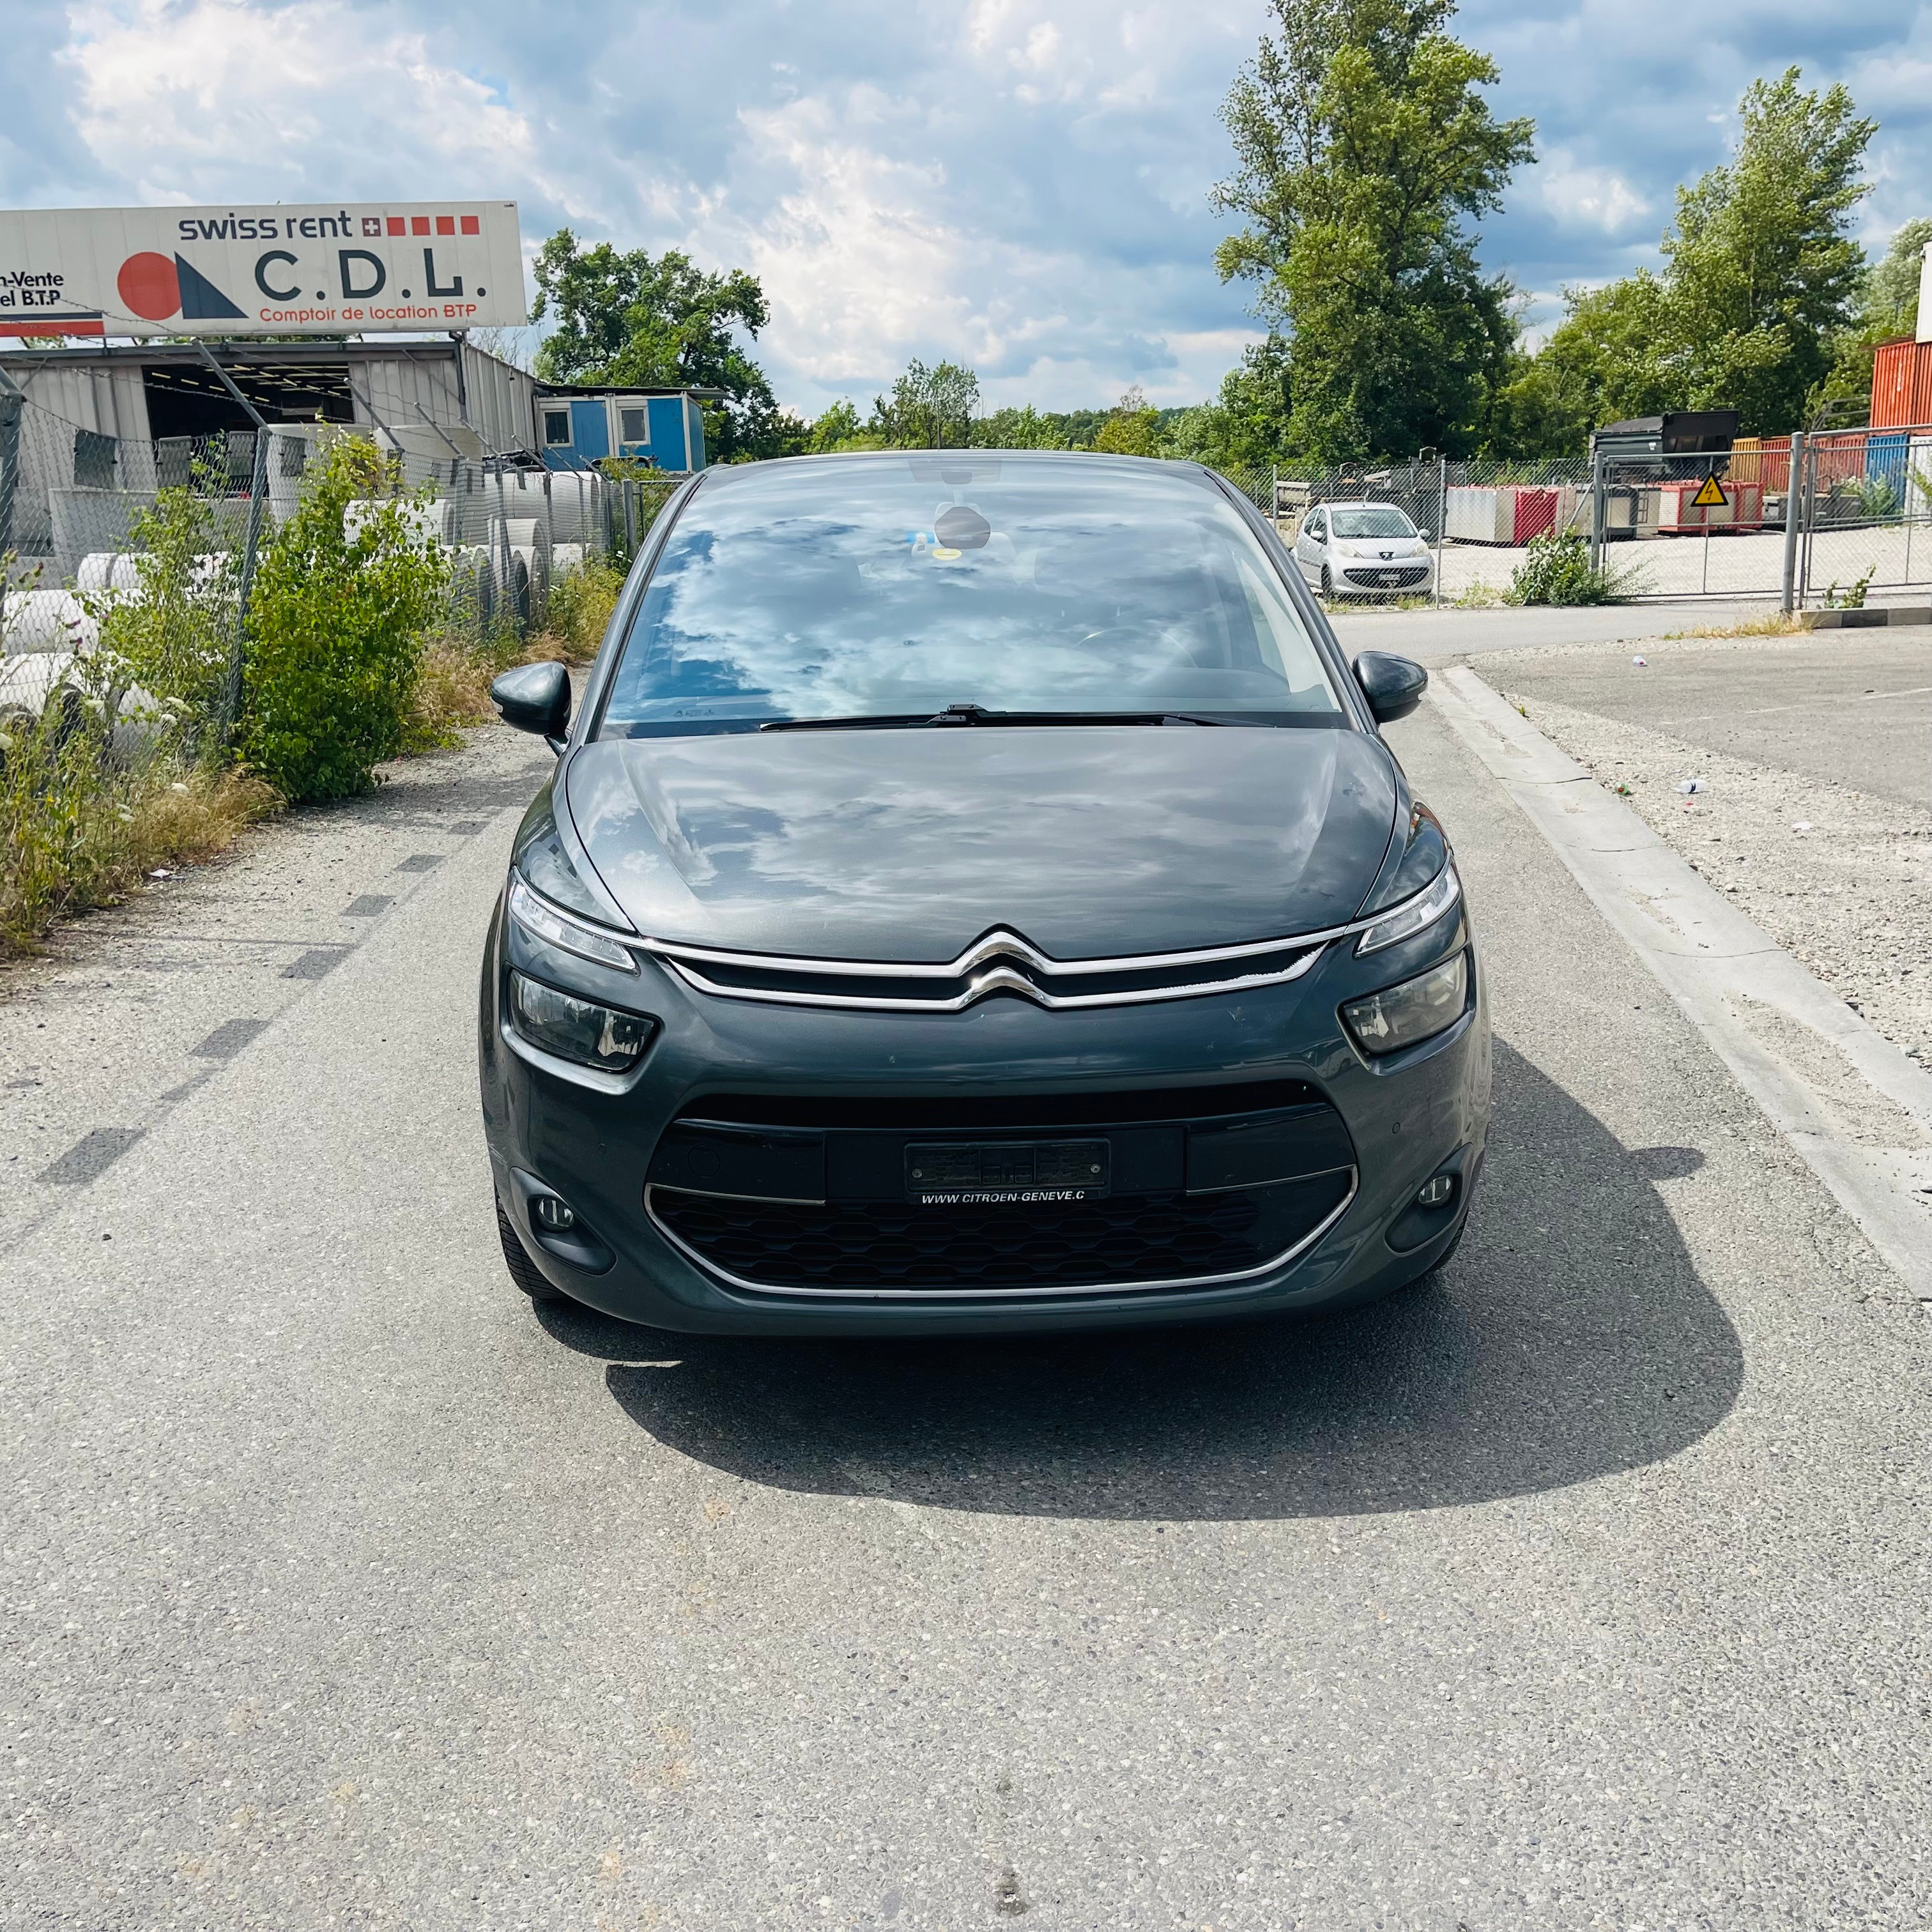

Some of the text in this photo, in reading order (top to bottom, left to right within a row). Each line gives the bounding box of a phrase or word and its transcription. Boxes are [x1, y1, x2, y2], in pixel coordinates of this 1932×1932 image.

[179, 210, 353, 240] swiss rent
[254, 248, 486, 302] C.D.L.
[259, 304, 477, 324] Comptoir de location BTP
